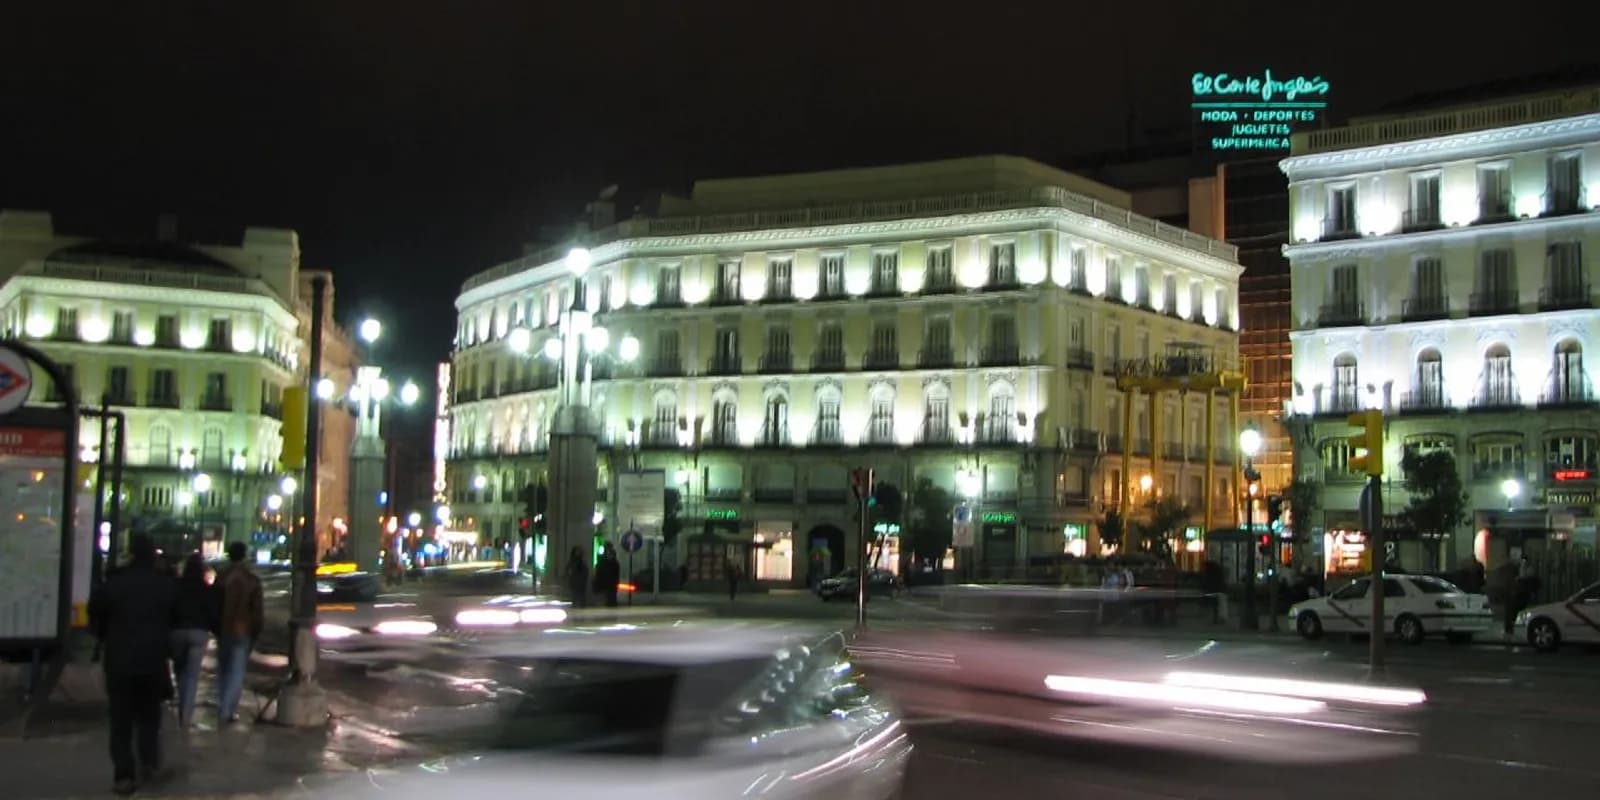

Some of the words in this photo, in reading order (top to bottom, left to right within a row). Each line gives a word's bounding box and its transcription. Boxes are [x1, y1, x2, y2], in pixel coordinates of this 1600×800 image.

[1192, 73, 1213, 94] El
[1214, 73, 1260, 94] Corte
[1201, 111, 1238, 121] MODA
[1253, 110, 1315, 121] DEPORTES
[1232, 124, 1290, 136] JUGUETES
